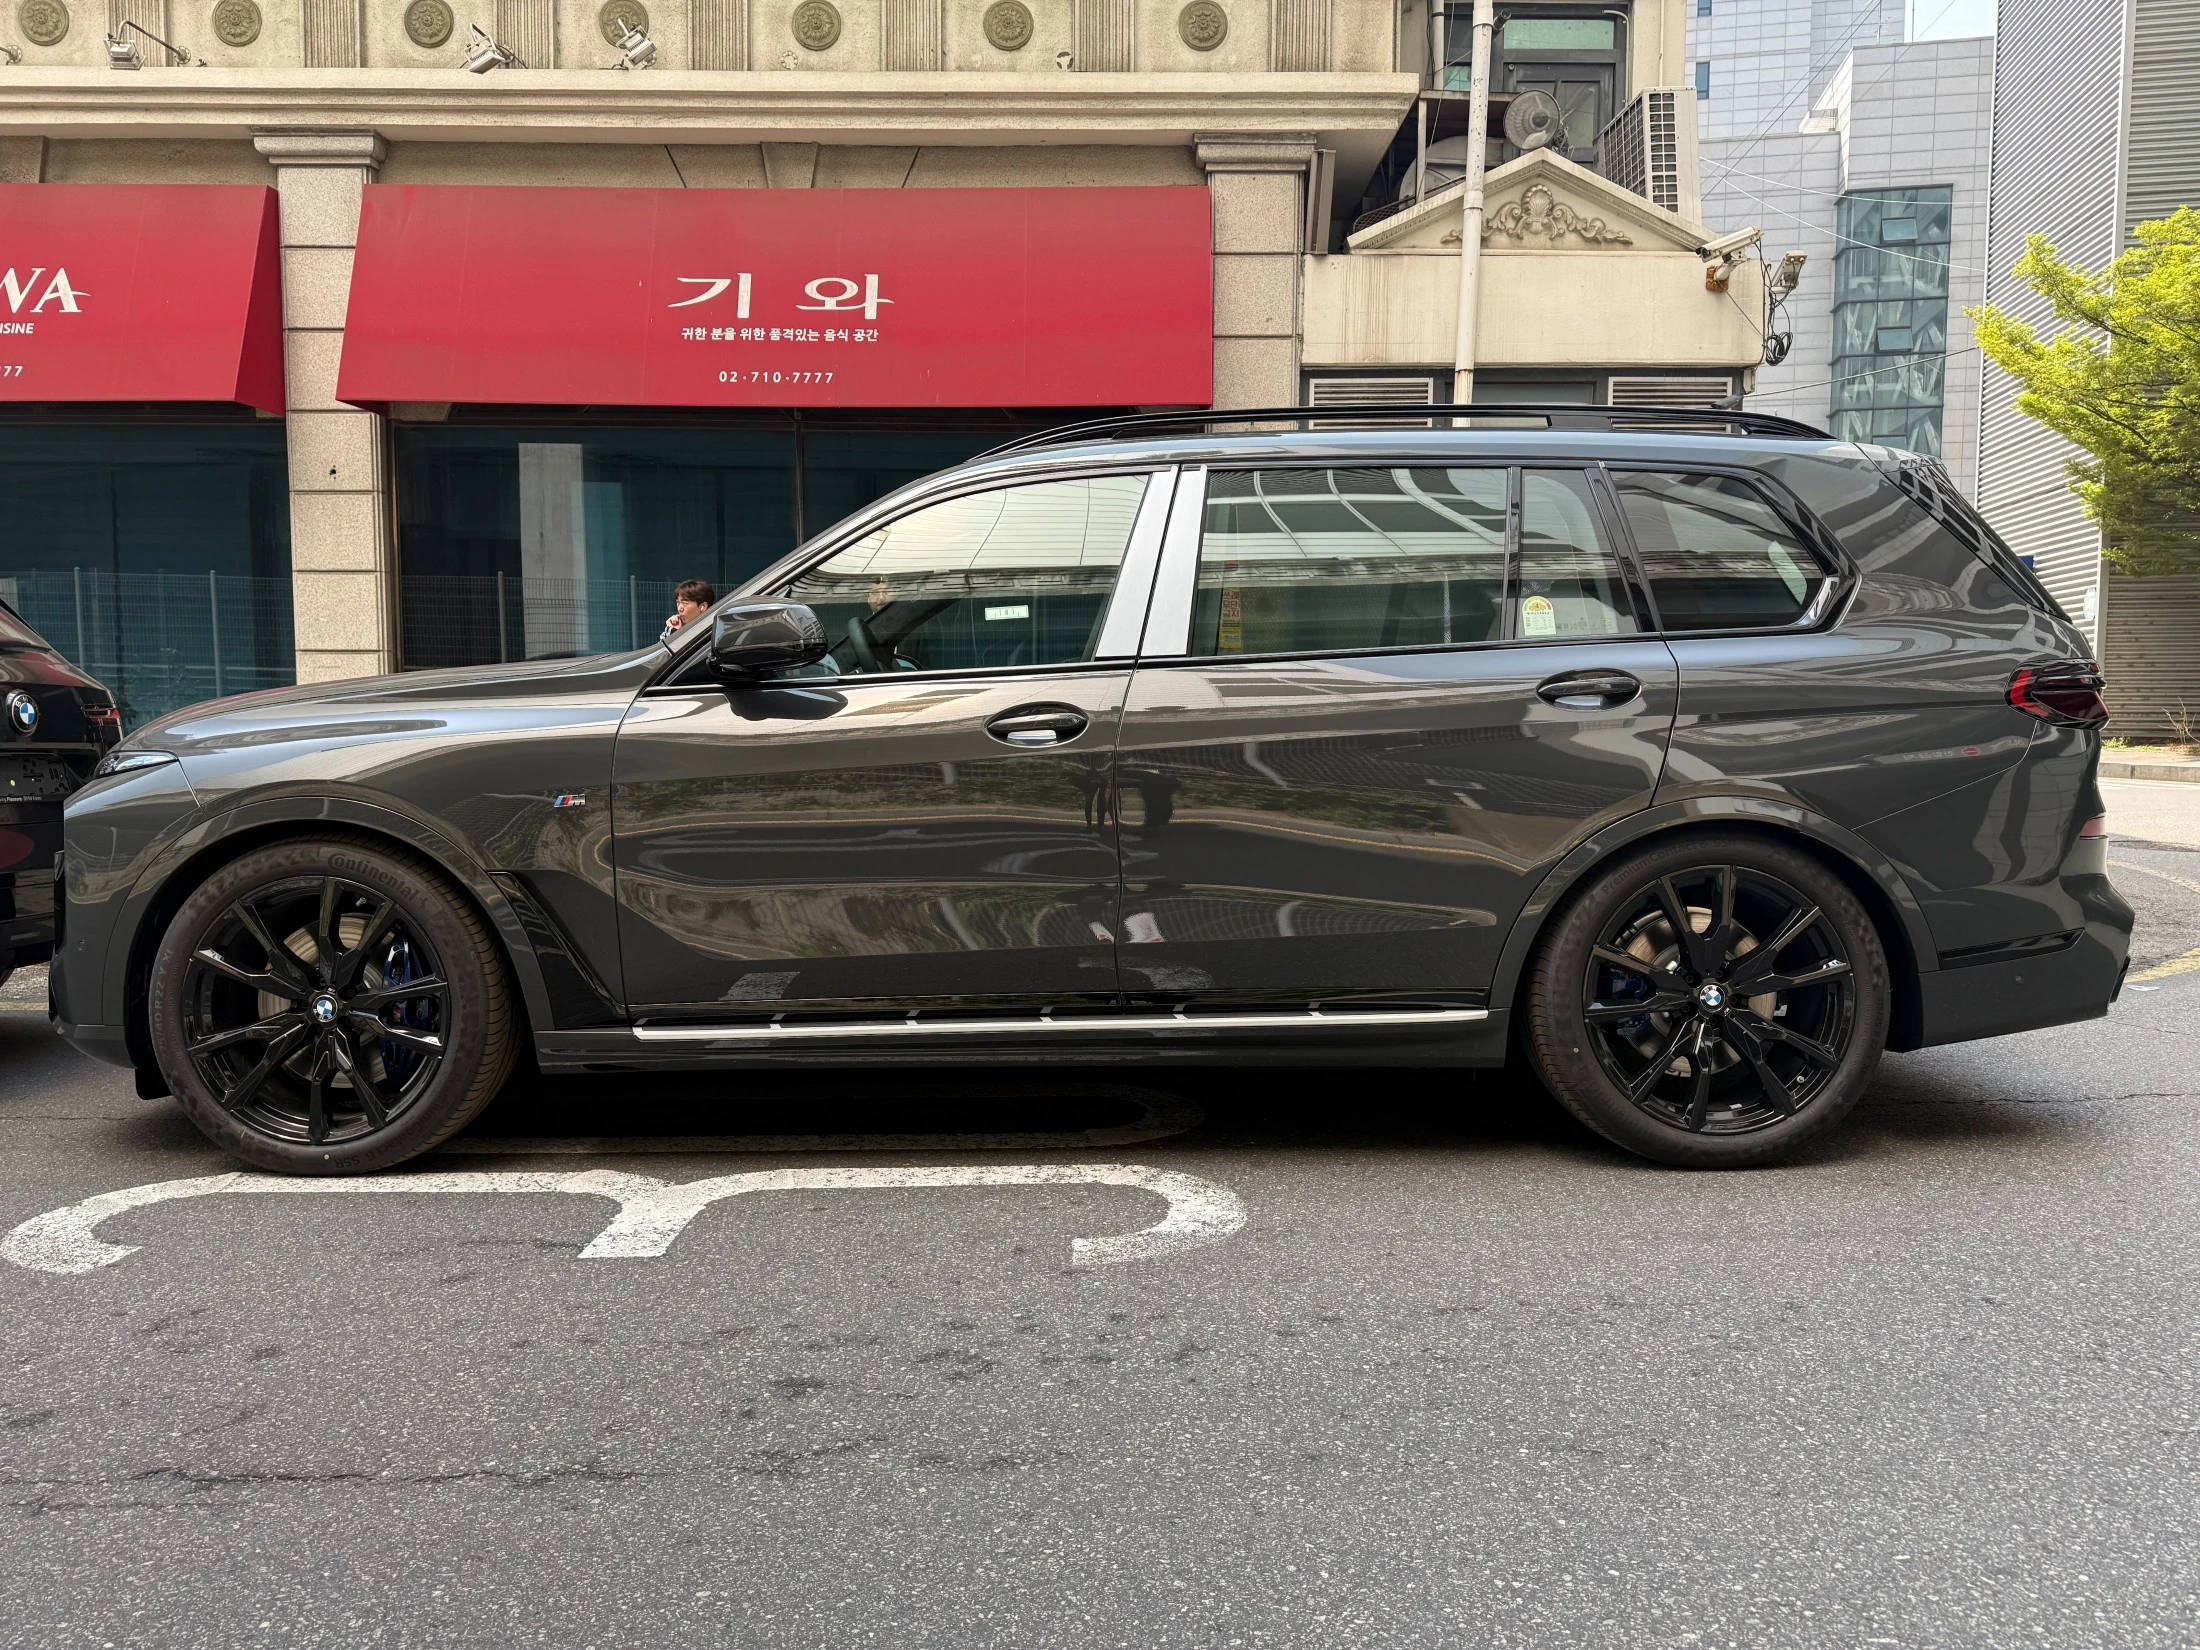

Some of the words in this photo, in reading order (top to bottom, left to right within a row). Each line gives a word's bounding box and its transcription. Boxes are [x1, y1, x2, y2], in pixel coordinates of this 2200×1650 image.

[681, 327, 707, 341] 귀한
[710, 327, 736, 341] 분을
[740, 327, 766, 341] 위한
[769, 327, 820, 342] 품격있는
[823, 328, 849, 342] 음식
[852, 328, 879, 342] 공간
[0, 366, 23, 377] 77
[328, 852, 422, 901] Continental
